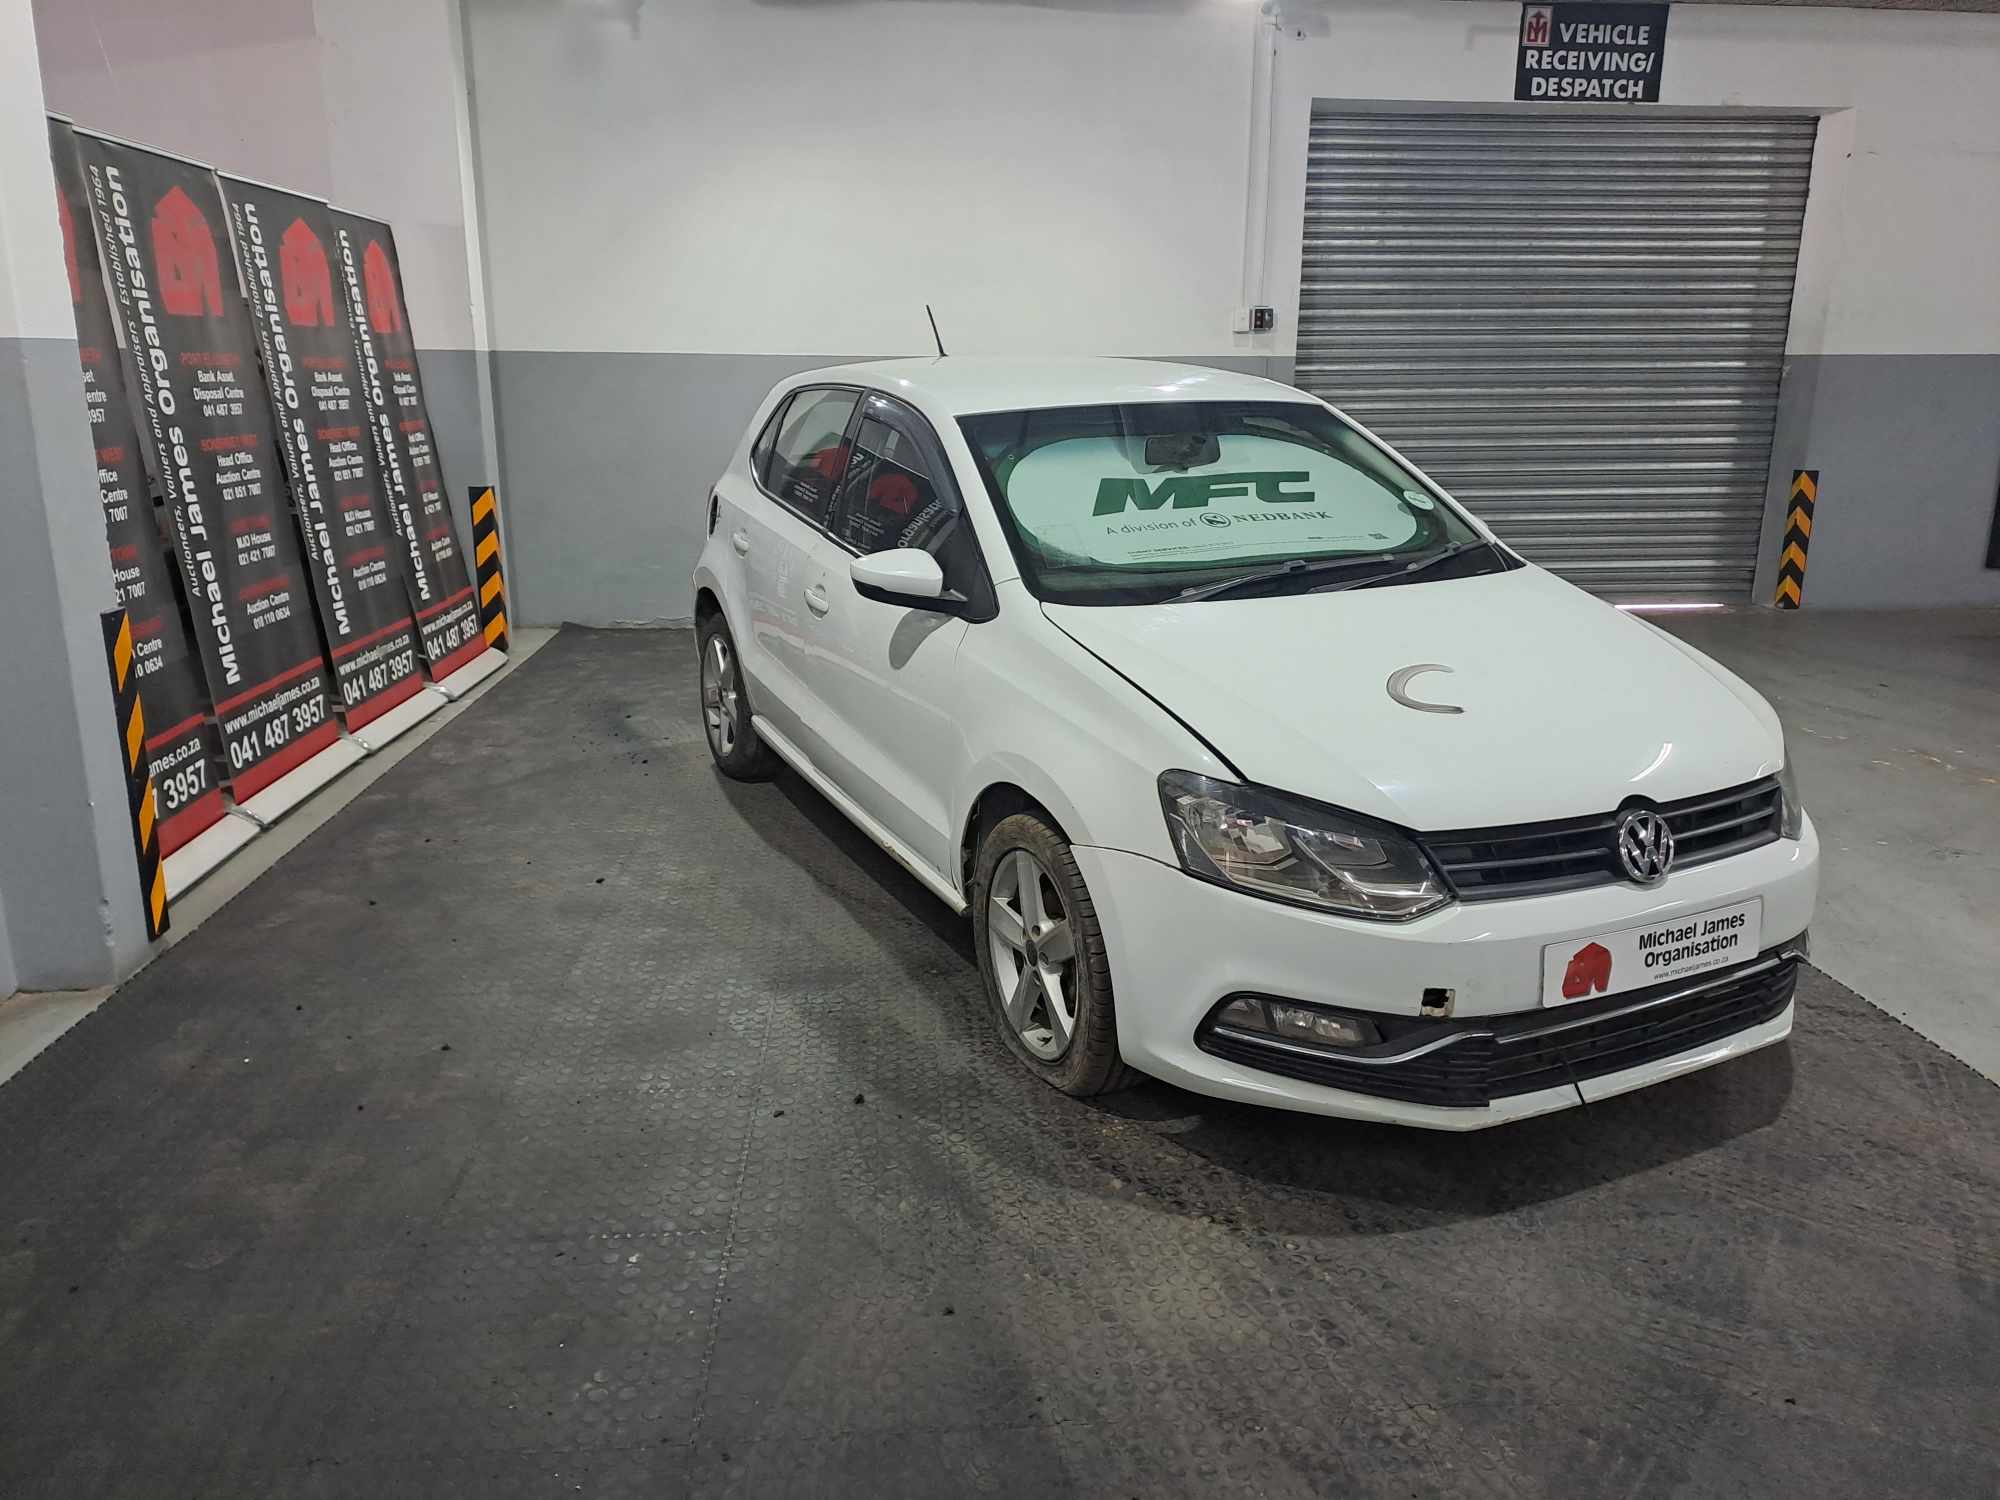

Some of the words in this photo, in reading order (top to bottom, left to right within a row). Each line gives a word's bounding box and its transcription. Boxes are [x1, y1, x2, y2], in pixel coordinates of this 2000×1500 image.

[1559, 23, 1650, 45] VEHICLE
[1525, 50, 1655, 73] RECEIVING/
[1531, 76, 1645, 99] DESPATCH
[89, 164, 107, 206] 1964
[102, 209, 130, 306] Established
[105, 166, 176, 415] Organisation
[244, 203, 299, 409] Organisation
[338, 229, 384, 406] Organisation
[128, 319, 155, 405] Appraisers
[86, 390, 107, 403] entre
[147, 408, 162, 438] and
[157, 442, 177, 499] Valuers
[293, 418, 323, 514] James
[379, 413, 406, 496] James
[100, 488, 128, 503] Centre
[168, 426, 208, 541] James
[1092, 471, 1316, 516] MFC
[108, 506, 128, 523] 7007
[1106, 526, 1118, 535] A
[1121, 520, 1180, 533] division
[1182, 518, 1198, 528] of
[1232, 511, 1335, 523] NEDBANK
[112, 566, 141, 583] House
[399, 503, 431, 600] Michael
[114, 586, 126, 603] 21
[127, 582, 146, 601] 7007
[314, 522, 351, 635] Michael
[196, 550, 241, 685] Michael
[426, 636, 446, 661] 041
[446, 626, 459, 649] 487
[461, 614, 478, 640] 3957
[136, 637, 163, 657] Centre
[144, 655, 163, 675] 0634
[343, 675, 367, 705] 041
[368, 661, 388, 693] 487
[388, 649, 414, 681] 3957
[224, 676, 320, 735] www.michaeljames.co.za
[230, 730, 262, 769] 041
[264, 714, 289, 749] 487
[292, 694, 326, 733] 3957
[163, 758, 206, 809] 3957
[1639, 922, 1697, 951] Michael
[1701, 913, 1745, 936] James
[1644, 933, 1738, 968] Organisation
